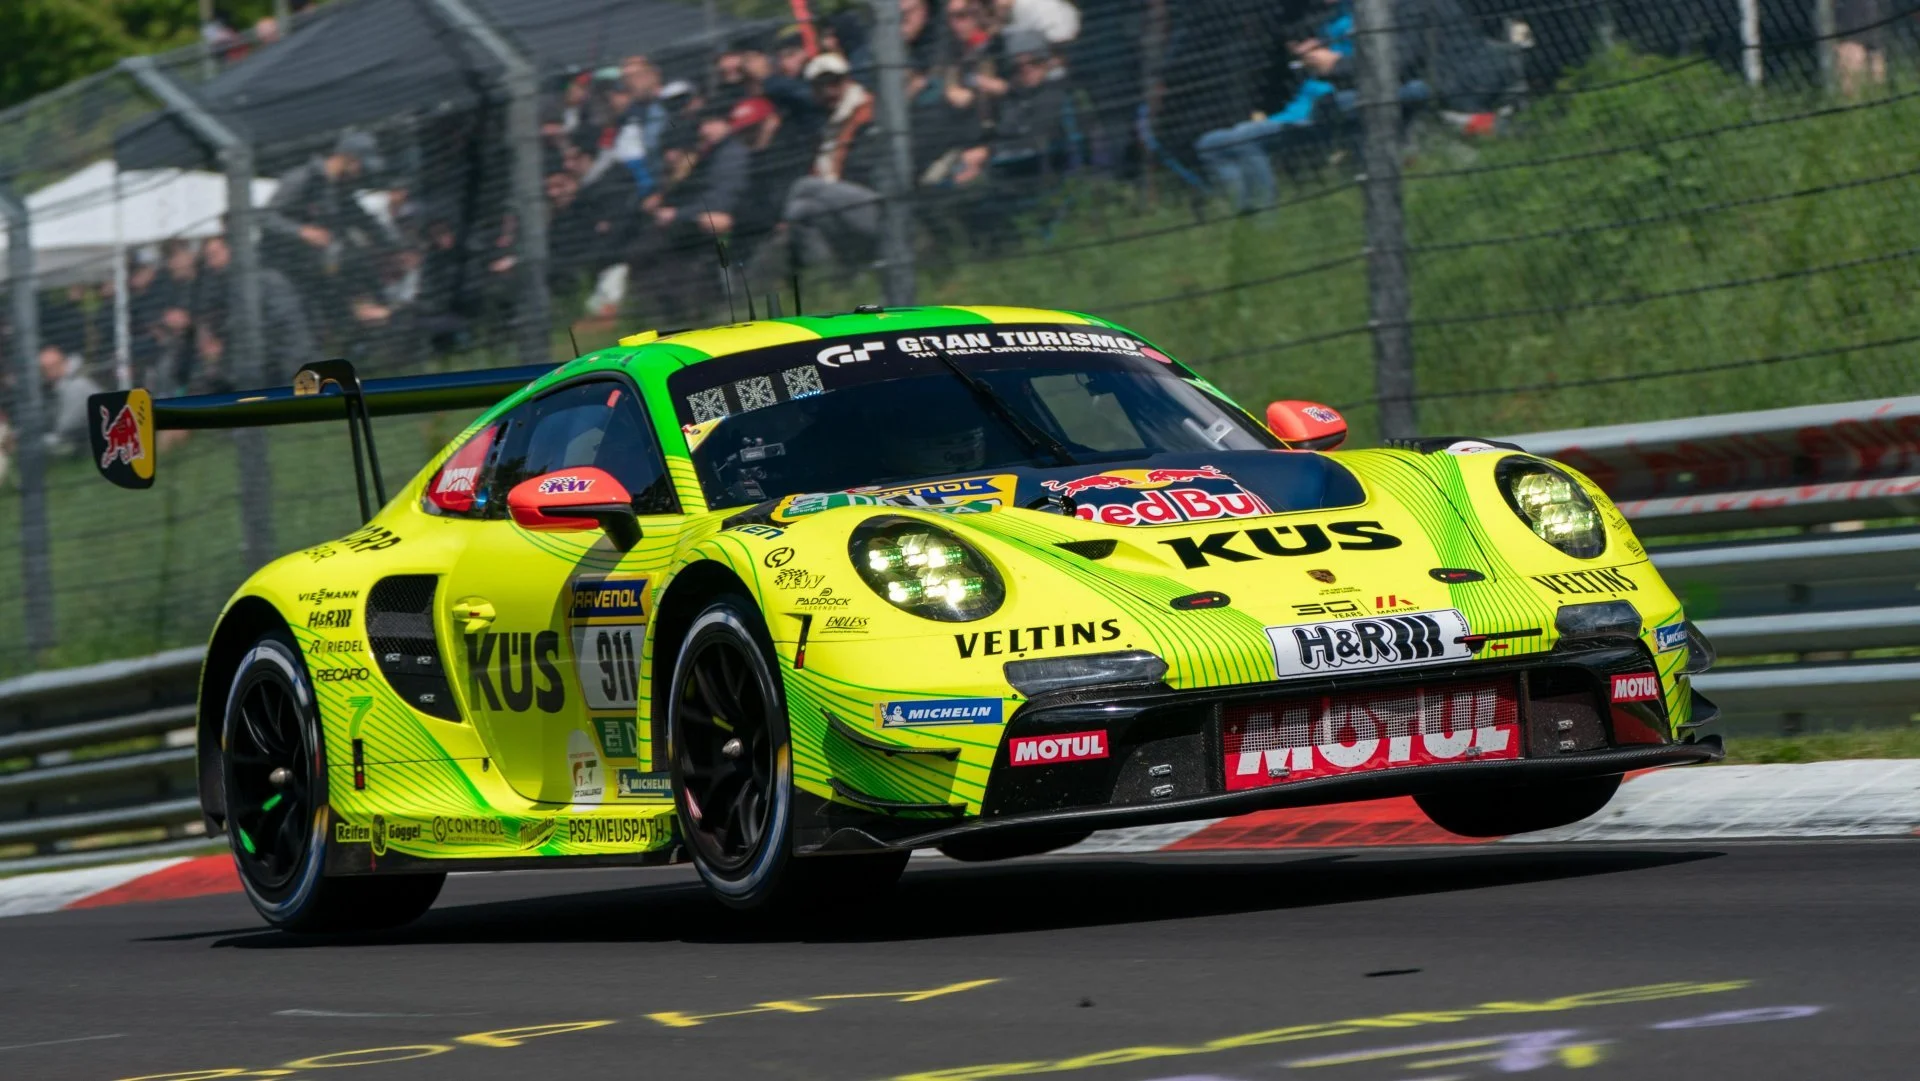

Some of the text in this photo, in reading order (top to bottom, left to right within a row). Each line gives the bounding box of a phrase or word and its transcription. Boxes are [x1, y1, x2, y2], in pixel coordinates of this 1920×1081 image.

[897, 331, 1137, 352] GRAN TURISMO
[945, 347, 989, 356] REAL
[1057, 346, 1145, 357] SIMULATOR
[546, 478, 593, 492] KW
[1157, 521, 1402, 570] KÜS
[1530, 567, 1638, 595] VELTINS
[299, 589, 359, 605] VIESSMANN
[575, 589, 639, 608] RAVENOL
[1292, 600, 1358, 616] 30
[1332, 611, 1364, 619] YEARS
[1376, 606, 1420, 615] MANTHEY
[826, 616, 870, 627] ENDLESS
[328, 640, 363, 652] RIEDEL
[954, 619, 1121, 659] VELTINS
[1293, 621, 1393, 665] H&R
[464, 630, 565, 713] KÜS
[597, 629, 638, 701] 911
[316, 668, 369, 682] RECARO
[1614, 676, 1657, 699] MOTUL
[908, 706, 991, 720] MICHELIN
[1237, 688, 1511, 775] MOTUL
[1015, 735, 1103, 762] MOTUL
[631, 778, 672, 790] MICHELIN
[338, 824, 421, 841] Reifen Göggel
[448, 818, 504, 835] CONTROL
[569, 818, 664, 842] PSZ MEUSPATH
